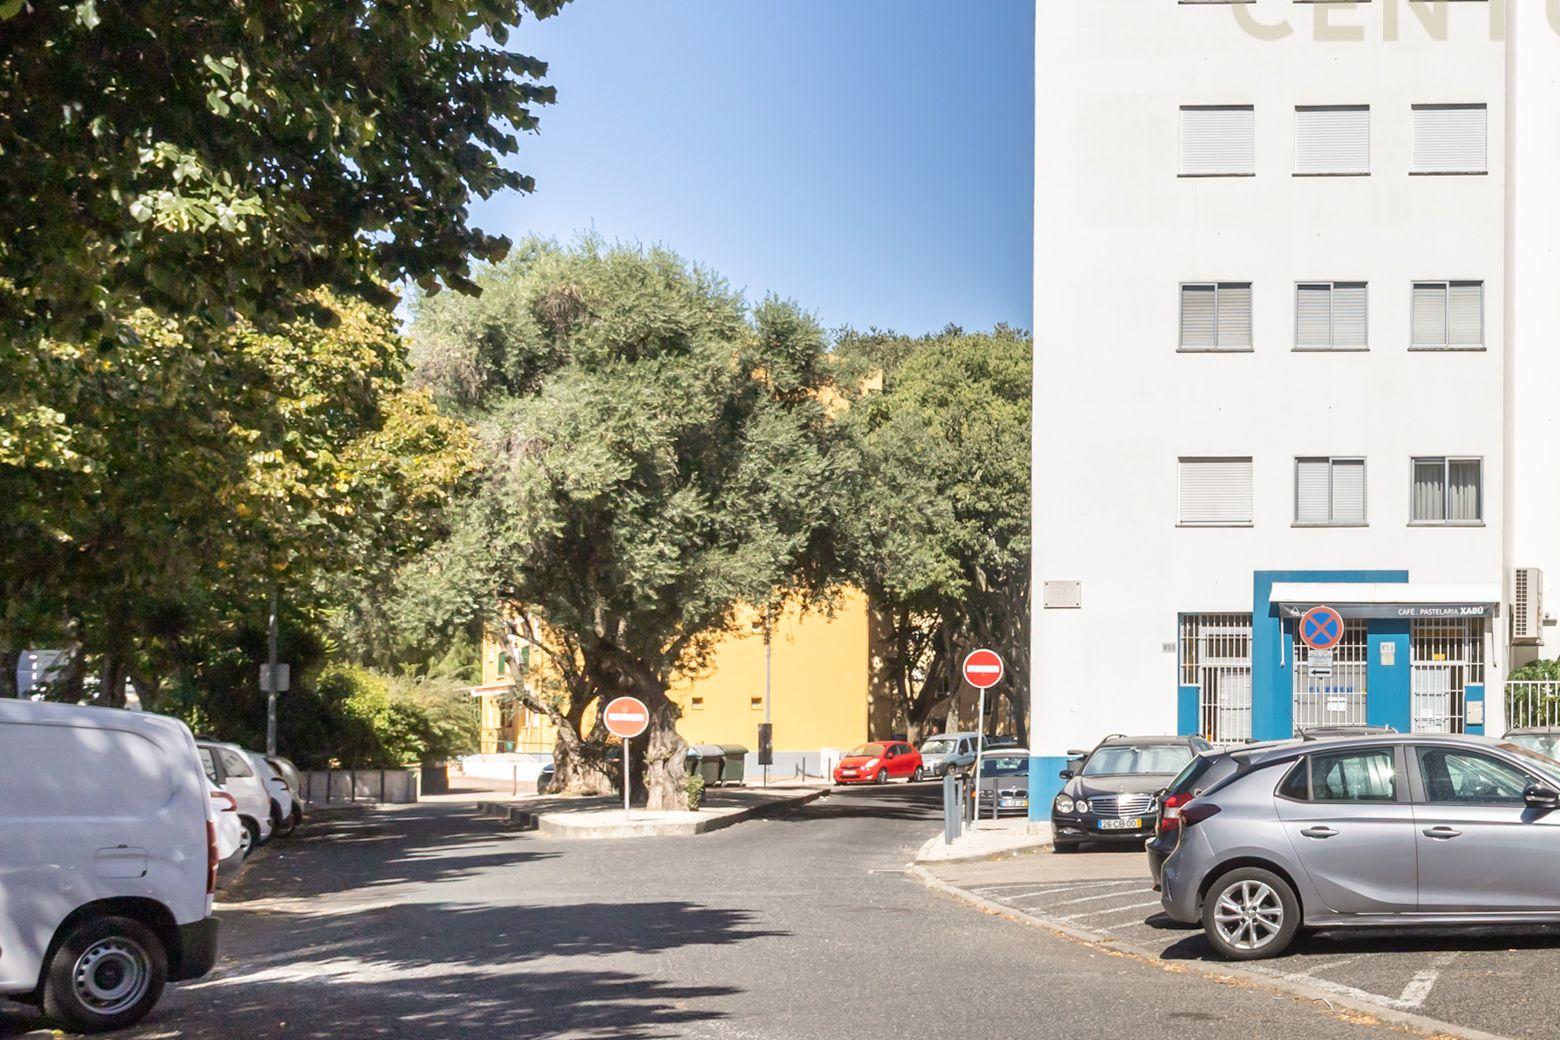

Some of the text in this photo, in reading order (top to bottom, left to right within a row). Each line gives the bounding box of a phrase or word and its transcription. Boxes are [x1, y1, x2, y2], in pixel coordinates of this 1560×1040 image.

[1397, 606, 1483, 616] CAFÉ PASTELARIA XABÚ
